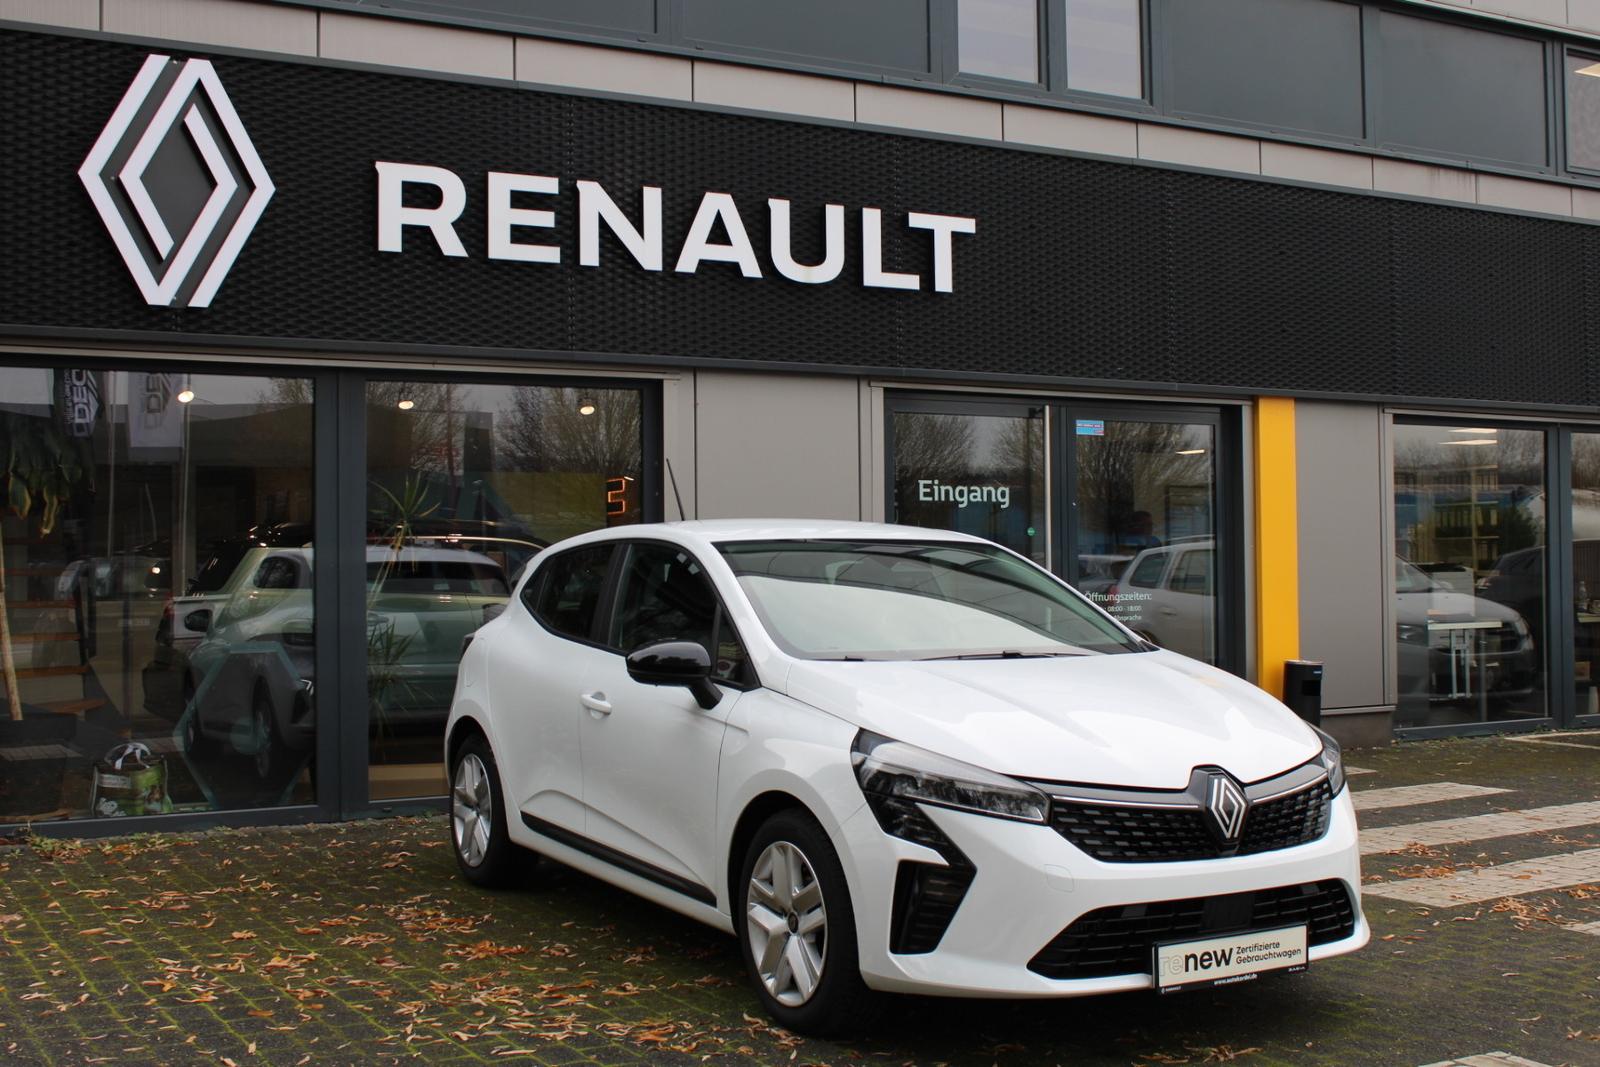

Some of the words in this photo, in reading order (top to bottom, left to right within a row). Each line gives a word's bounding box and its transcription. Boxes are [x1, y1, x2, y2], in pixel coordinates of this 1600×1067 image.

[375, 160, 976, 294] RENAULT
[917, 479, 1010, 509] Eingang
[1235, 948, 1302, 965] Gebrauchtwagen
[1236, 941, 1281, 955] Zertifizierte
